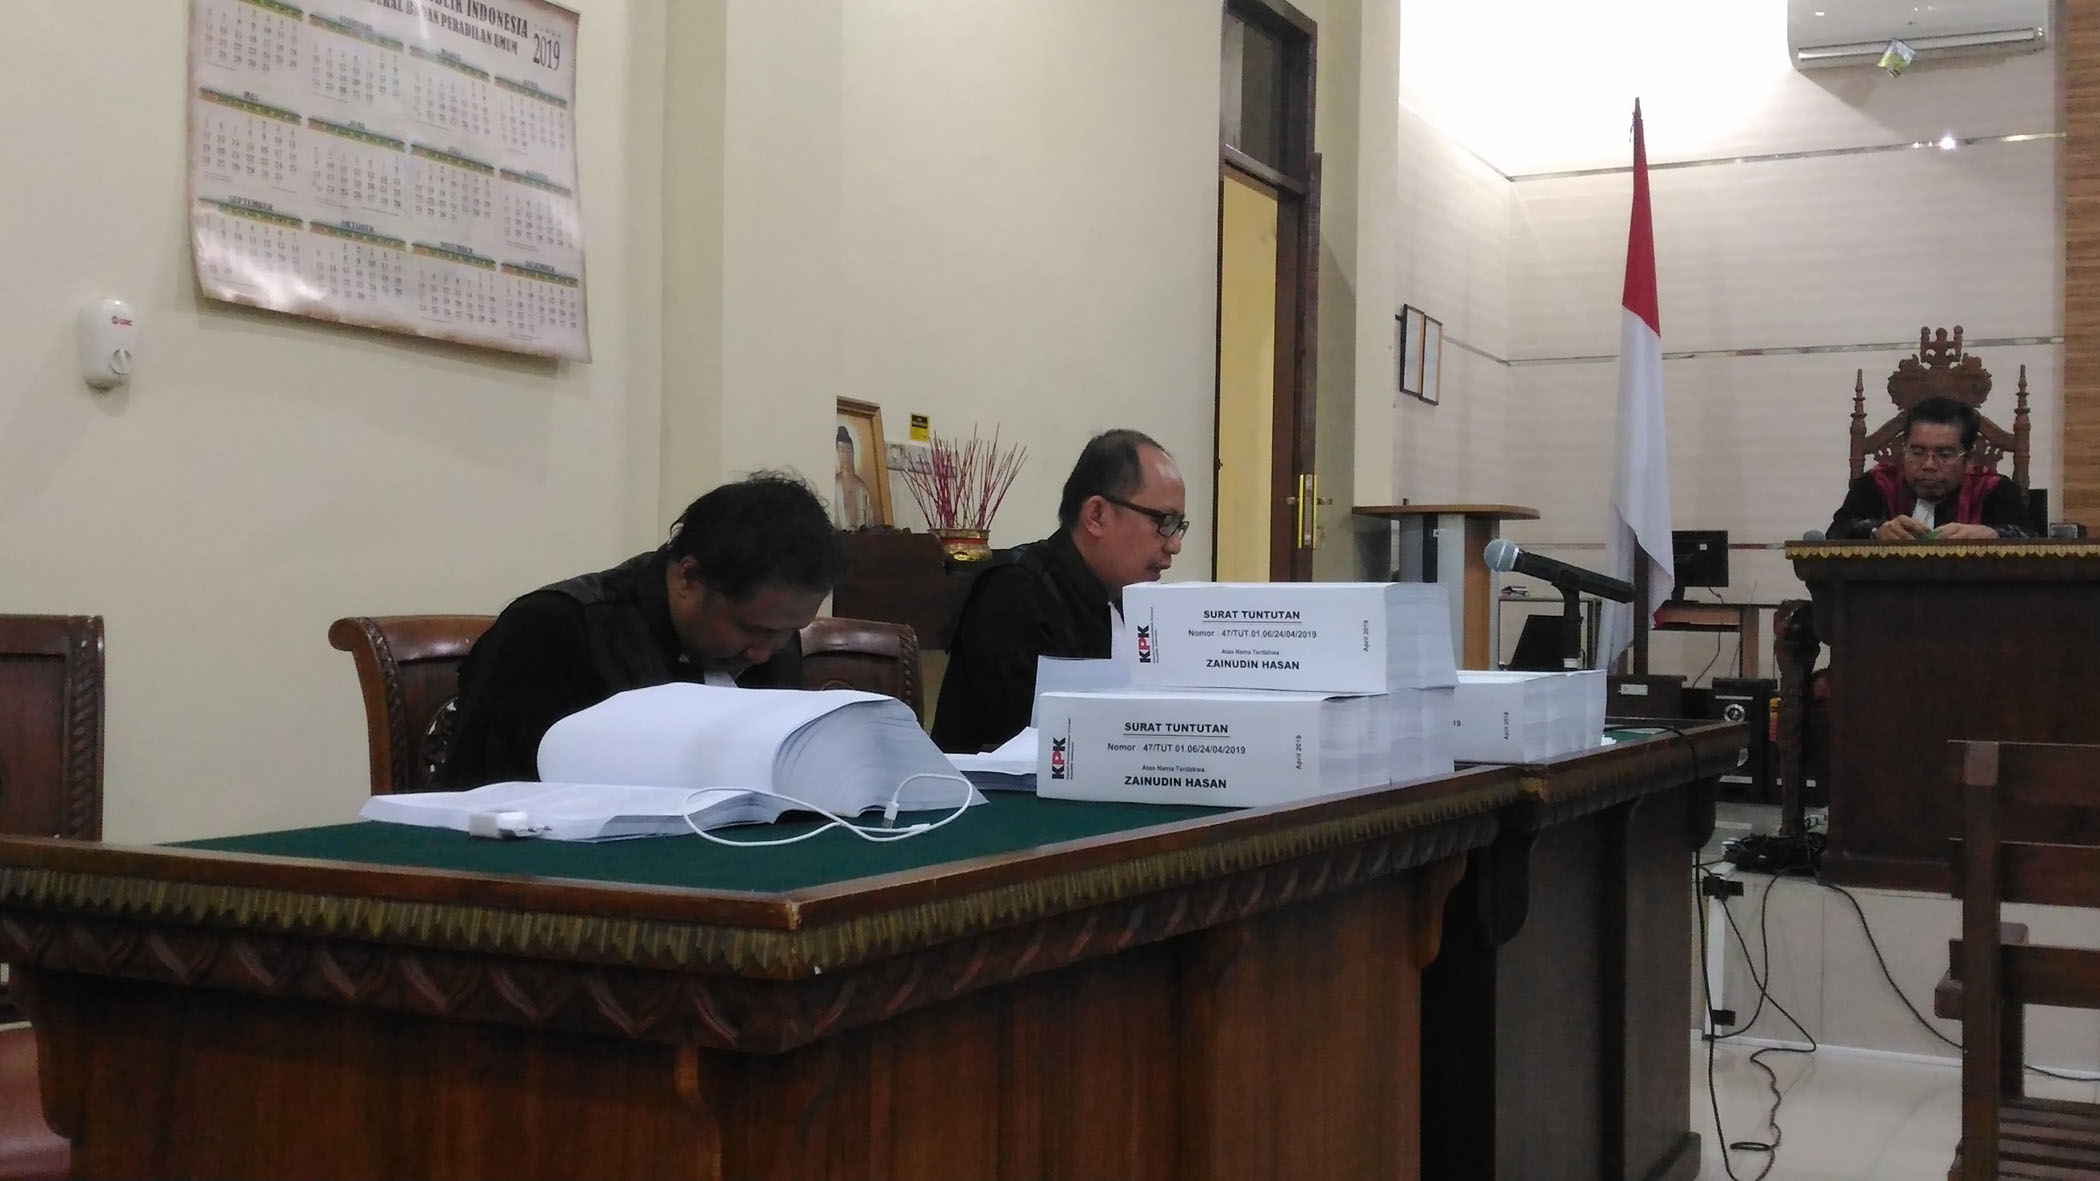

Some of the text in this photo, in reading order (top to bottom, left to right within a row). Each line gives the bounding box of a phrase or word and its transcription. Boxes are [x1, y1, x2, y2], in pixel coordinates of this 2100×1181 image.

[467, 0, 528, 39] INDONESIA
[440, 12, 492, 45] PERADILAN
[494, 33, 518, 55] UMUM
[532, 32, 561, 71] 2019
[341, 220, 376, 233] OKTOBER
[1203, 610, 1301, 620] SURAT TUNTUTAN
[1188, 629, 1215, 637] Nomor
[1136, 624, 1152, 663] KPK
[1206, 659, 1300, 670] ZAINUDIN HASAN
[1124, 722, 1229, 734] SURAT TUNTUTAN
[1107, 742, 1136, 751] Nomor
[1051, 737, 1066, 780] KPK
[1124, 775, 1228, 789] ZAINUDIN HASAN
